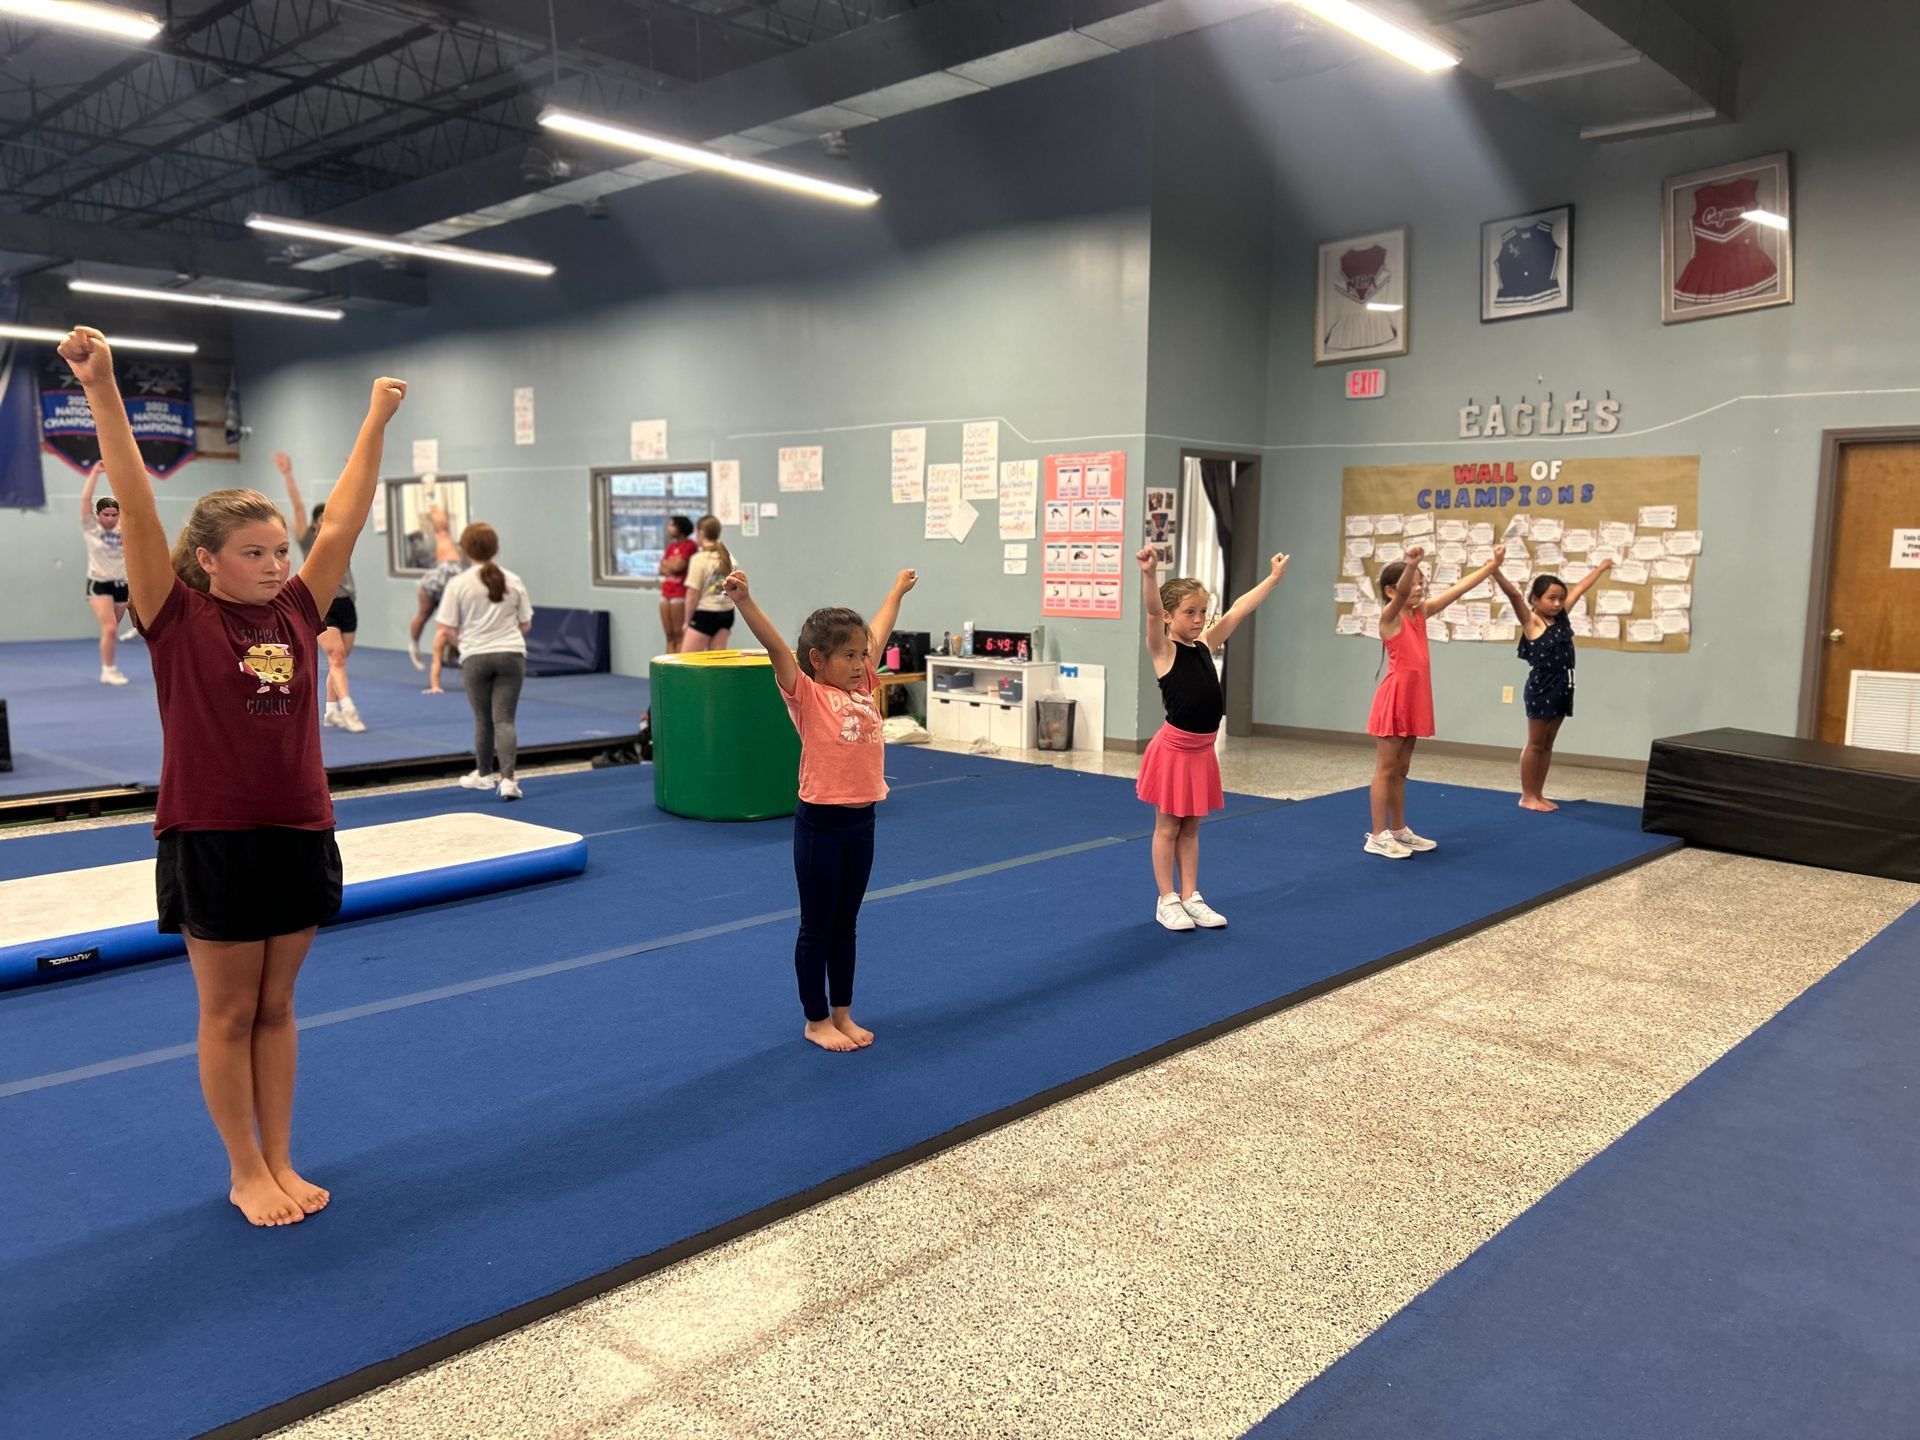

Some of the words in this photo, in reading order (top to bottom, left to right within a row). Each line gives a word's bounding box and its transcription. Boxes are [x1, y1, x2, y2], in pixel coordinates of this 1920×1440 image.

[1351, 370, 1380, 396] EXIT
[132, 413, 184, 425] NATIONAL
[1459, 399, 1620, 438] EAGLES
[1454, 462, 1518, 485] WALL
[1530, 460, 1563, 481] OF
[1416, 483, 1595, 510] CHAMPIONS
